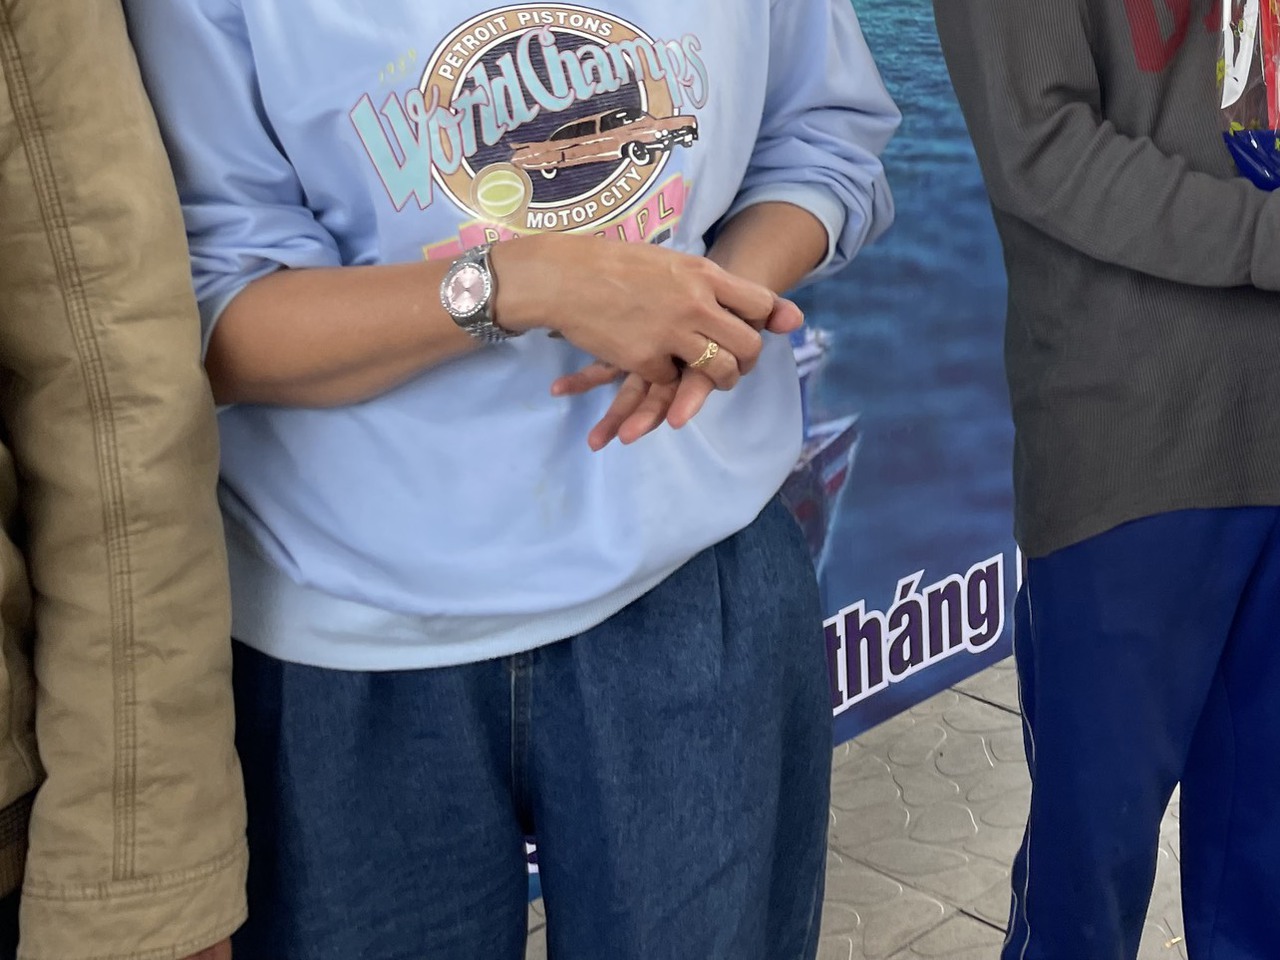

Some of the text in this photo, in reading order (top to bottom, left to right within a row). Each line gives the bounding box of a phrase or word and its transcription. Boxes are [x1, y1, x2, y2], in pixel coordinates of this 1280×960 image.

[518, 11, 612, 37] PISTONS
[349, 24, 709, 212] World Champs
[602, 169, 643, 207] CITY
